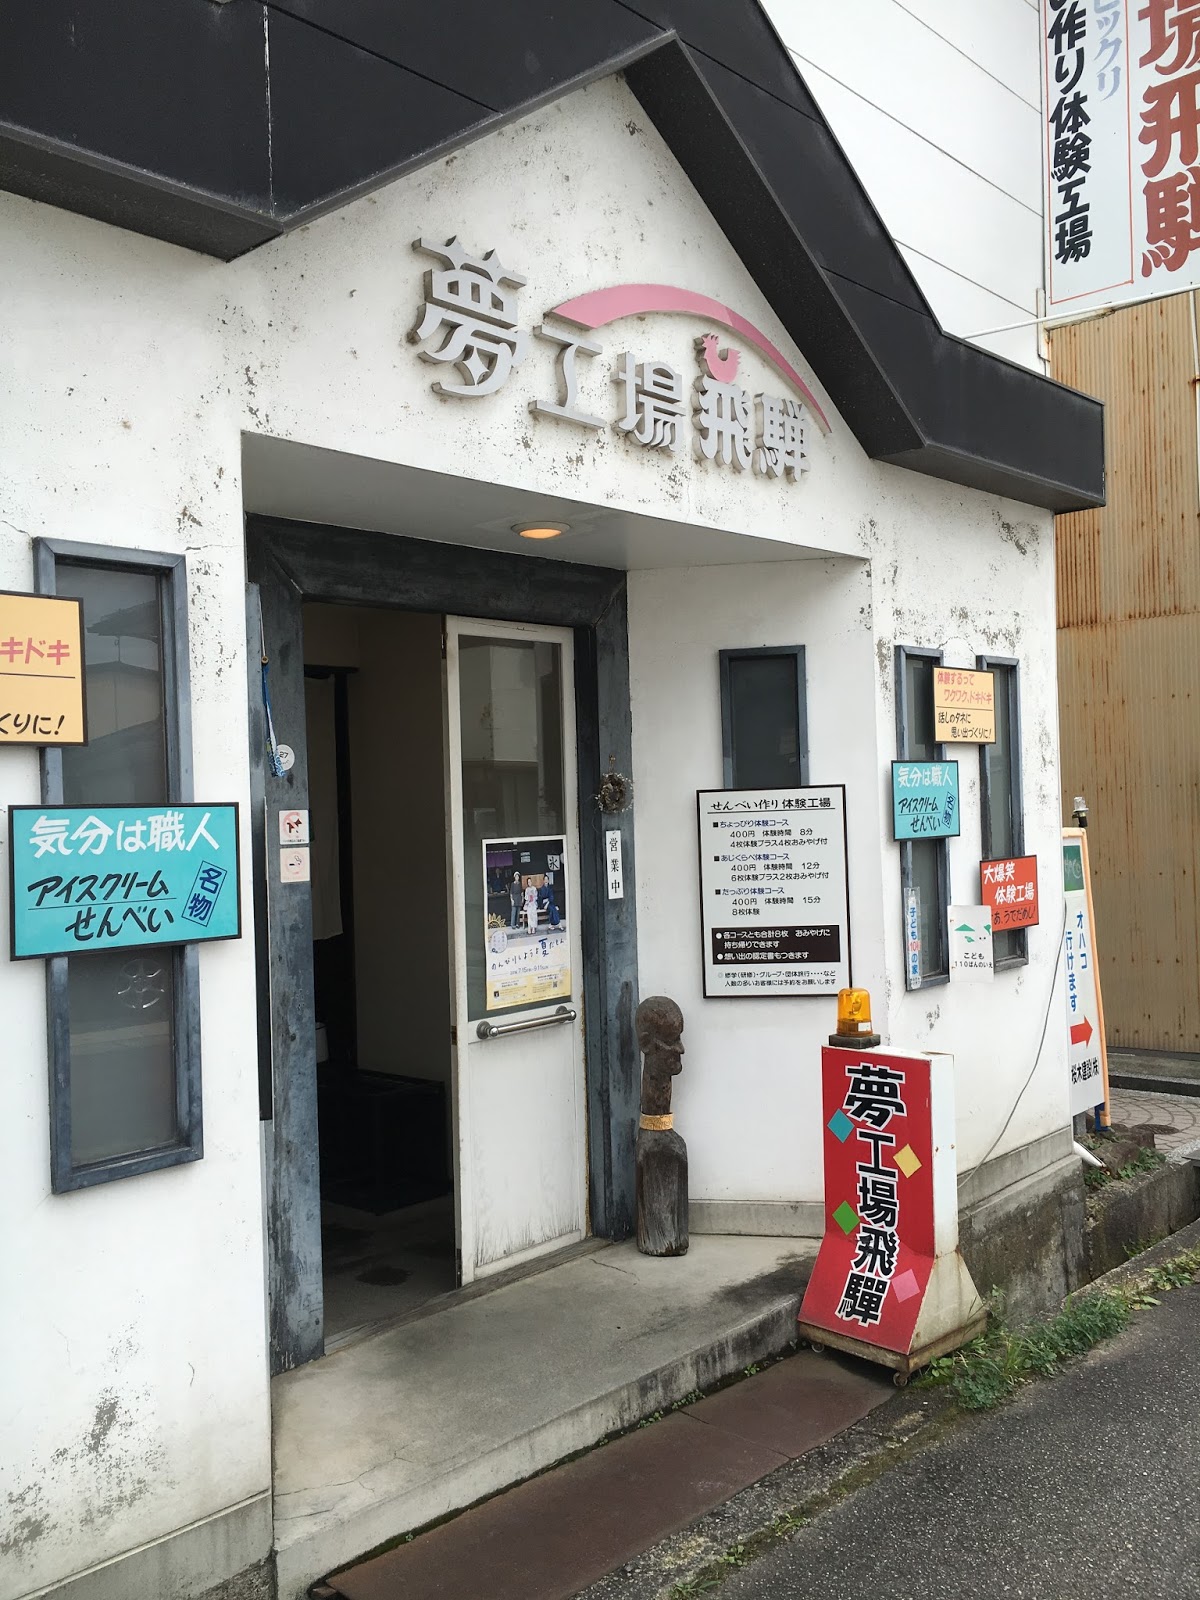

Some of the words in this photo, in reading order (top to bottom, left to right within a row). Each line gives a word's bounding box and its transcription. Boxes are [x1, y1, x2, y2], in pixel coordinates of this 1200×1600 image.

[937, 670, 975, 686] 体験するって
[938, 711, 971, 724] 話しのタネに
[898, 765, 953, 788] 気分は職人
[781, 797, 831, 809] 体験工場
[898, 797, 939, 813] アイスクリーム
[730, 830, 755, 838] 400円
[762, 829, 792, 837] 体験時間
[800, 828, 813, 836] 8分
[910, 815, 941, 833] せんべい
[29, 810, 220, 859] 気分は職人
[609, 837, 620, 894] 営業中
[731, 864, 756, 872] 400円
[763, 863, 793, 871] 体験時間
[801, 861, 820, 870] 12分
[984, 861, 1015, 885] 大爆笑
[27, 870, 169, 907] アイスクリーム
[188, 867, 222, 921] 名物
[995, 882, 1034, 905] 体験工場
[732, 898, 757, 906] 400円
[765, 897, 794, 905] 体験時間
[803, 896, 821, 904] 15分
[732, 908, 760, 916] 8枚体験
[65, 905, 174, 941] せんべい
[1077, 911, 1088, 969] オハコ
[963, 952, 985, 960] こども
